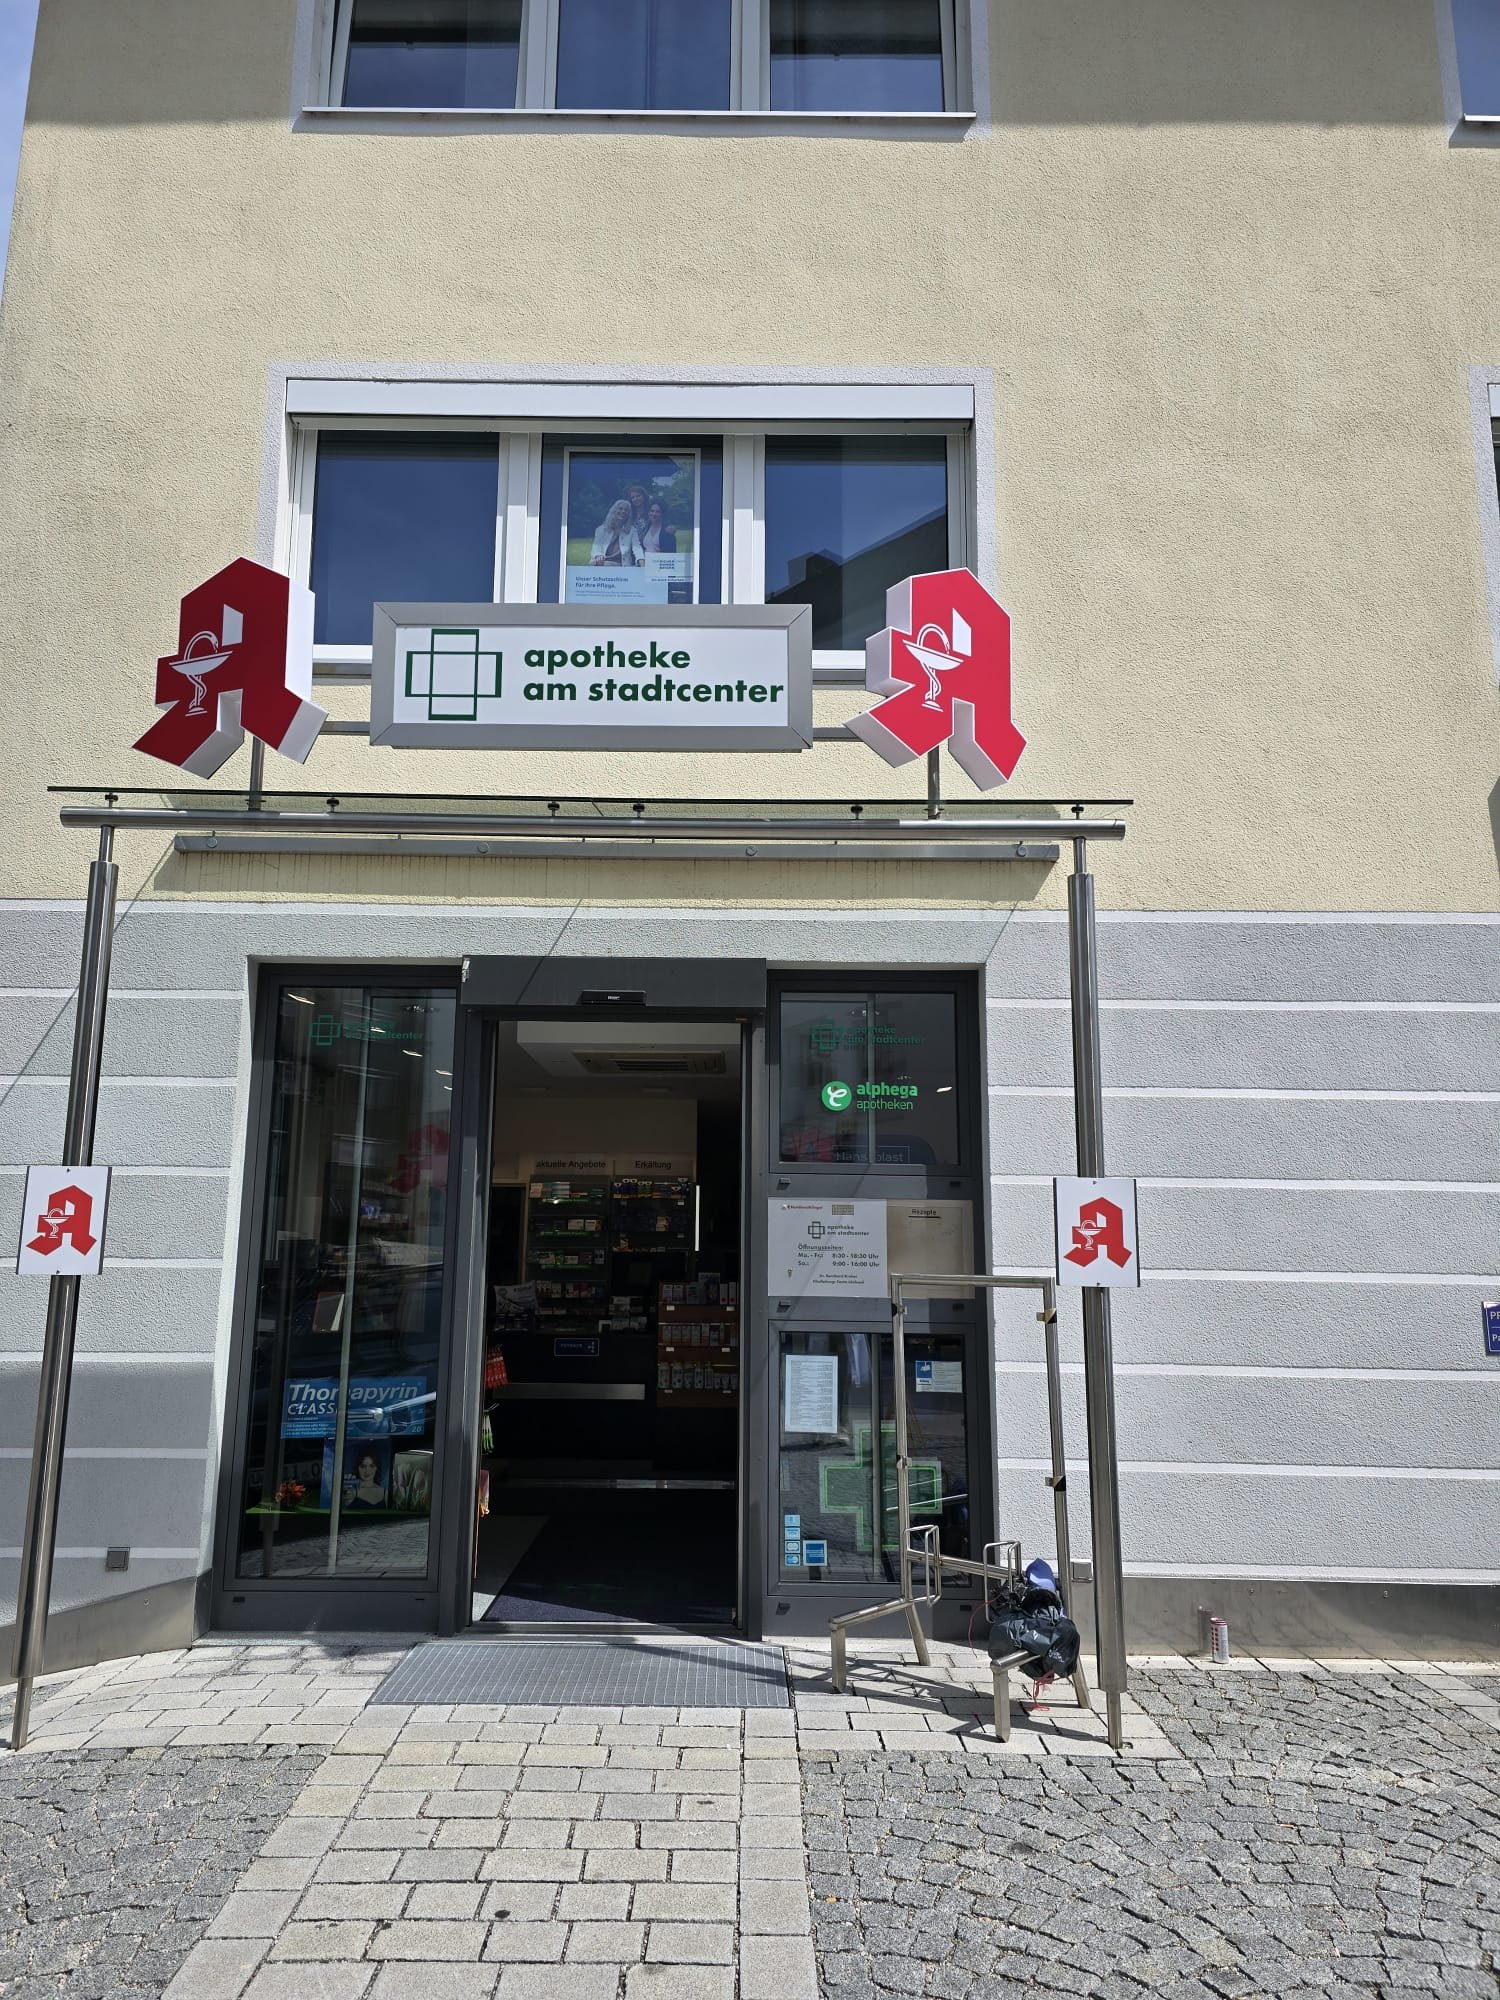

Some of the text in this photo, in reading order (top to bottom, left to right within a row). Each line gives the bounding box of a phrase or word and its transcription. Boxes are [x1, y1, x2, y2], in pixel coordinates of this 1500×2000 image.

[524, 641, 691, 675] apotheke
[523, 674, 785, 704] am stadtcenter
[856, 1082, 918, 1099] alphega
[856, 1099, 913, 1112] apotheken
[536, 1160, 606, 1170] aktuelle Angebote
[635, 1159, 672, 1170] Erkältung
